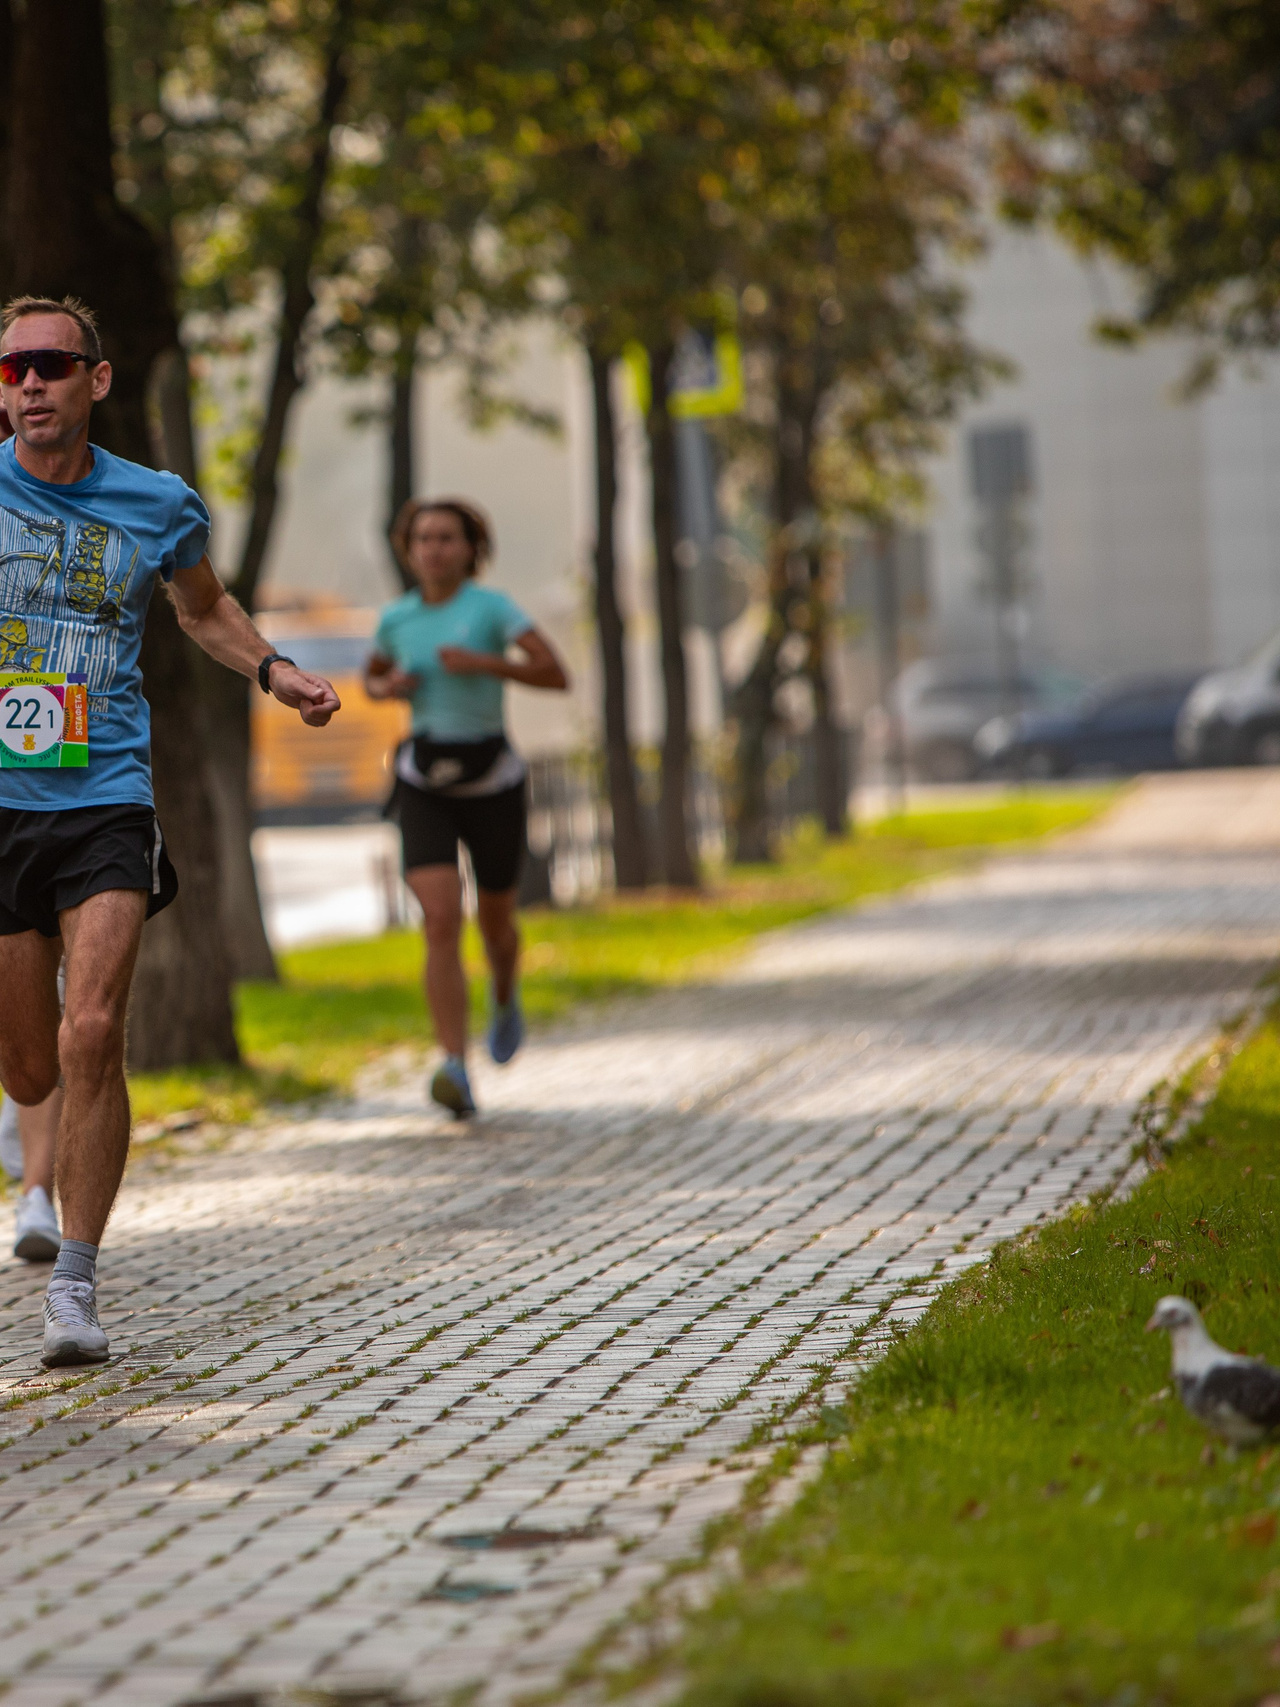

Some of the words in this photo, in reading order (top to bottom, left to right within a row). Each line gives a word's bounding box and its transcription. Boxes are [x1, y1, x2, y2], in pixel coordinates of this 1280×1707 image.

[46, 620, 119, 693] FINISHER
[15, 676, 34, 684] TRAIL
[35, 677, 62, 698] LYSKOVO
[5, 698, 41, 729] 22
[47, 709, 53, 729] 1
[74, 693, 83, 736] ЭСТАФЕТА
[2, 748, 27, 763] KANNAS
[37, 751, 51, 762] ЛЕС
